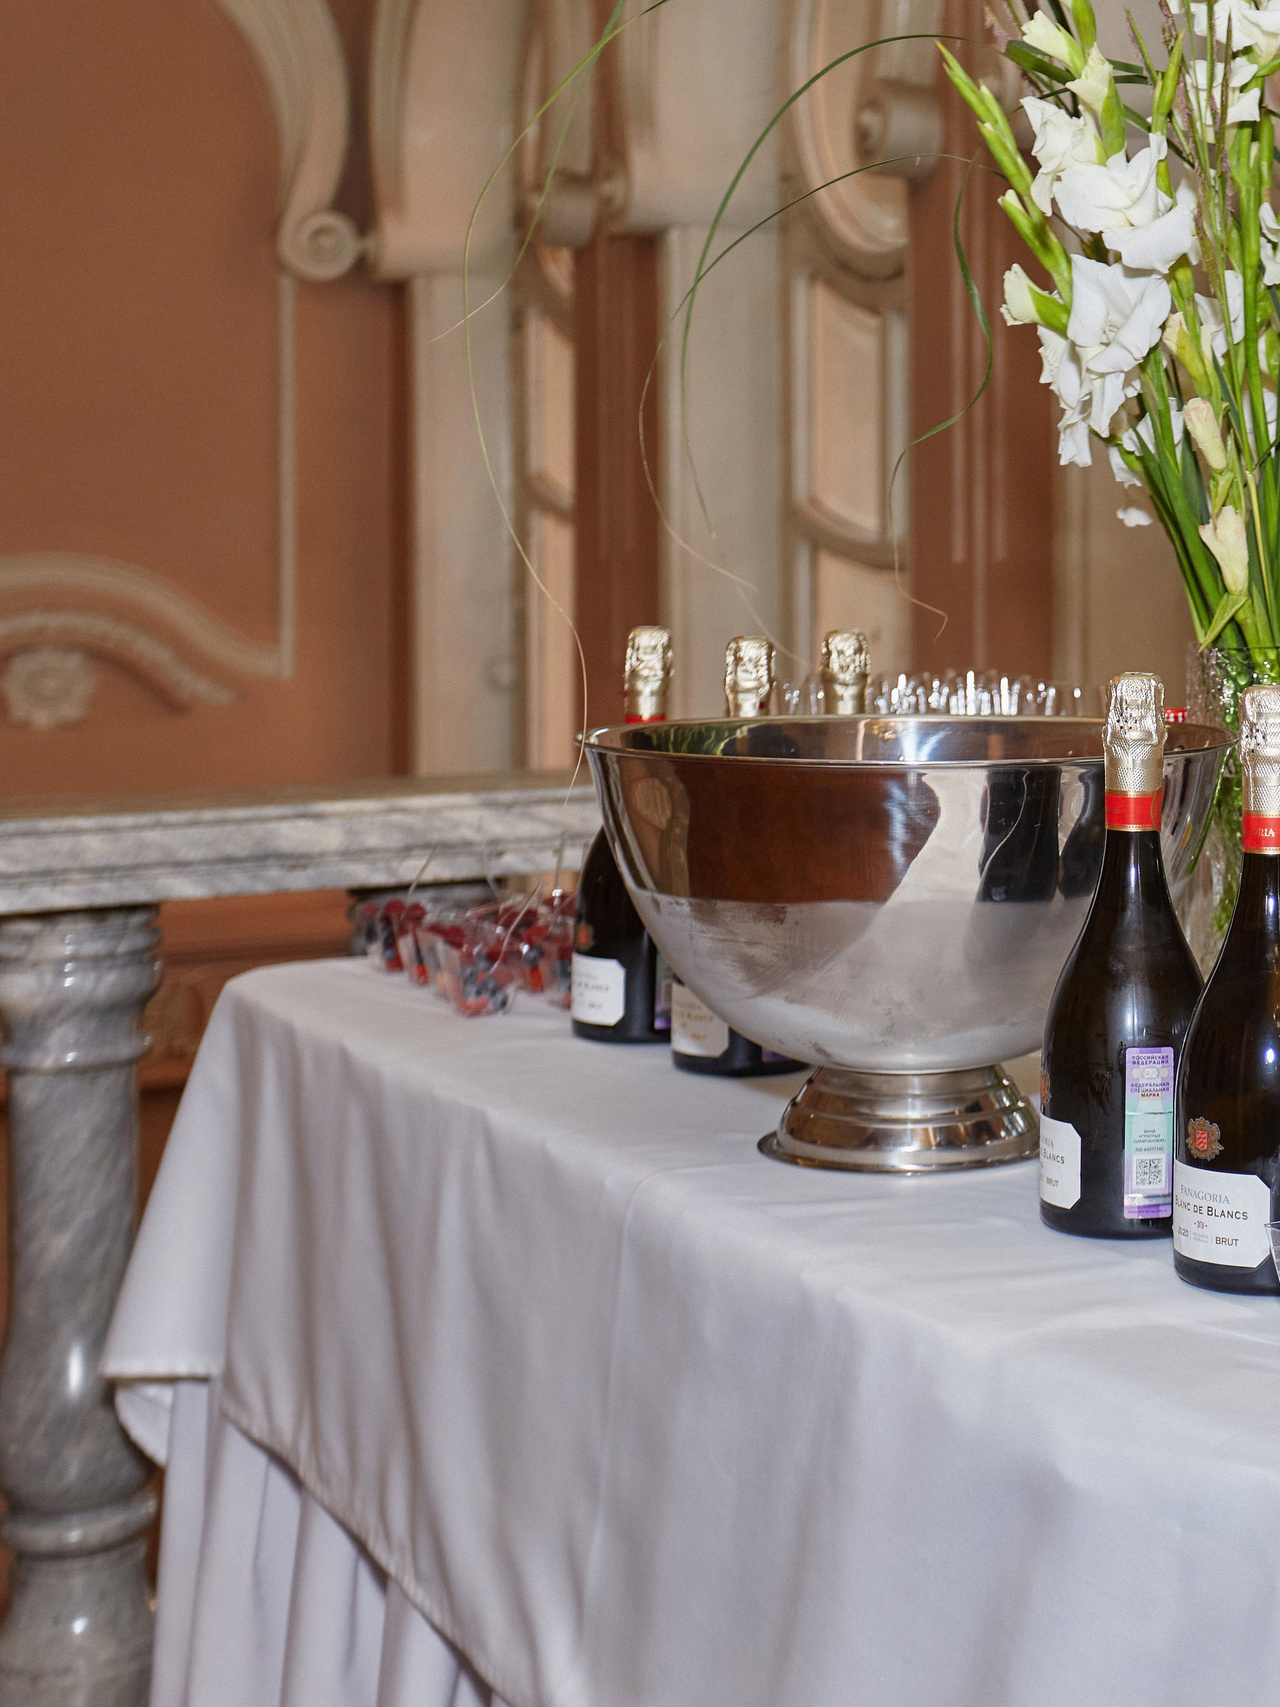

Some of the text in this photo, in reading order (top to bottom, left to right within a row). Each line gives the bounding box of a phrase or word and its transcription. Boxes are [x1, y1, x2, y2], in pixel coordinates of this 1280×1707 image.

[1043, 1147, 1065, 1165] BLANCS
[1180, 1184, 1230, 1205] FANAGORIA
[1175, 1194, 1249, 1221] BLANC DE BLANCS
[1215, 1236, 1240, 1247] BRUT
